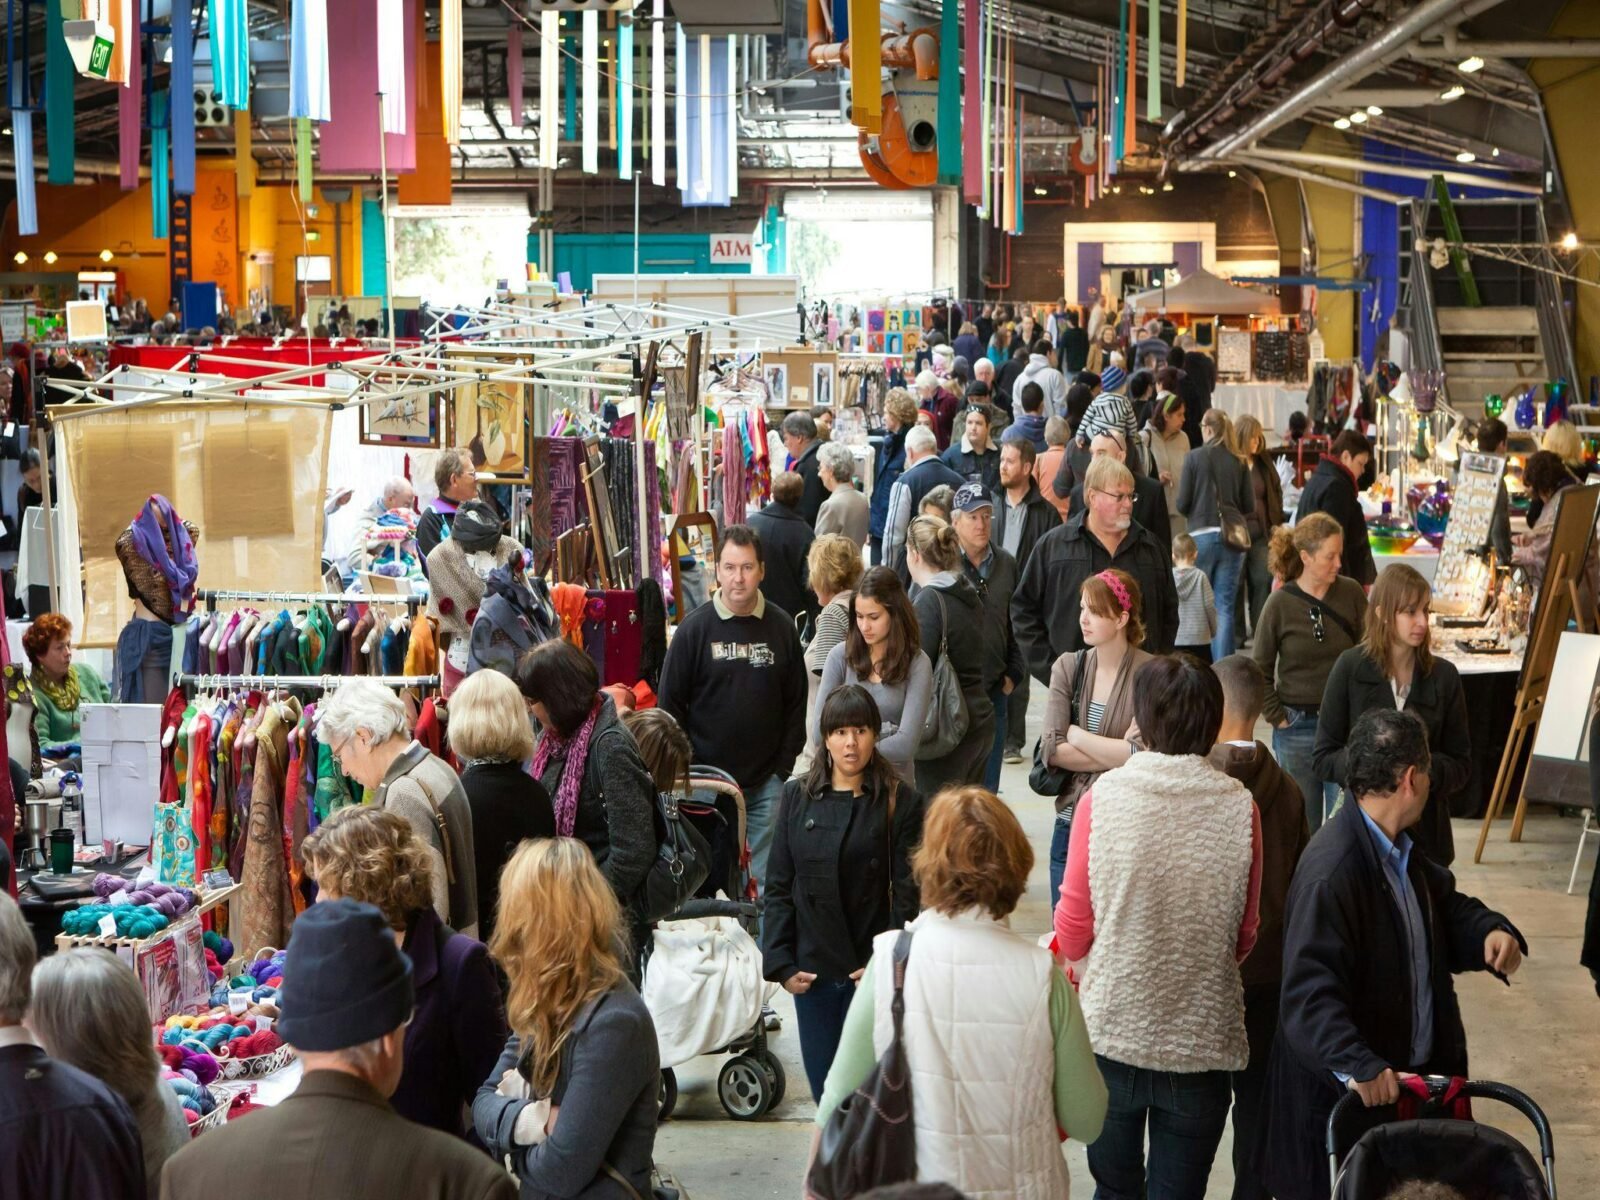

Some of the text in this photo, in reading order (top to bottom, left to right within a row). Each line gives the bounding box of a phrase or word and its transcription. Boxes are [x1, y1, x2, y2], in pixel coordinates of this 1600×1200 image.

[93, 42, 109, 71] EXIT
[712, 239, 751, 257] ATM
[711, 641, 775, 665] BillAb
